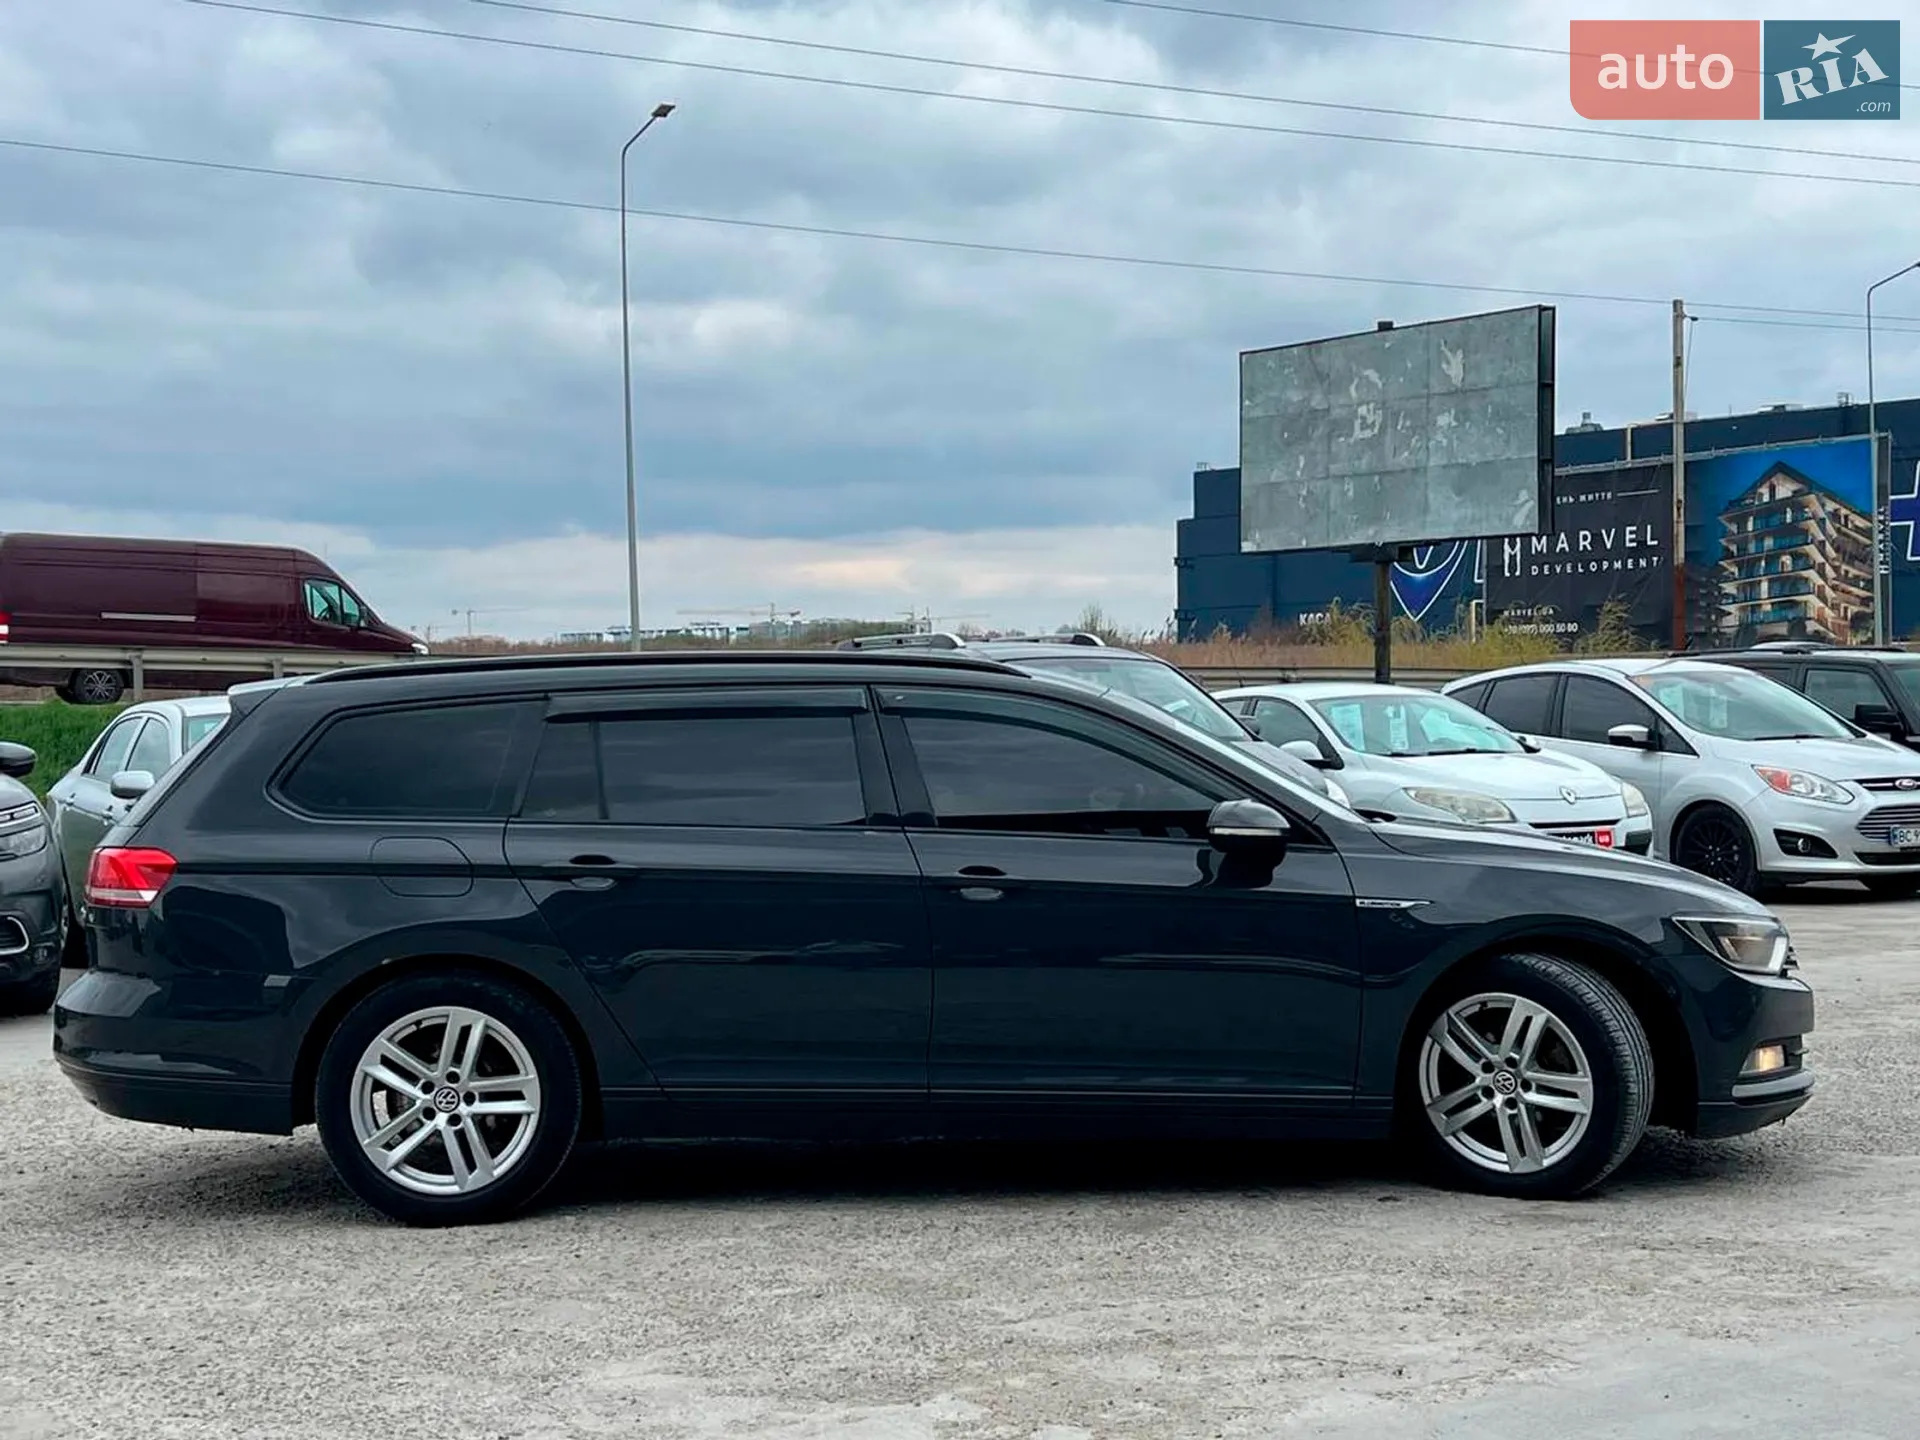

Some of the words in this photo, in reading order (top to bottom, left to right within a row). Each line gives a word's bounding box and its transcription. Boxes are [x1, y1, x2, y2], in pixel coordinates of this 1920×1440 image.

[1555, 495, 1575, 505] ЕНЬ
[1531, 524, 1659, 555] MARVEL
[1531, 556, 1660, 576] DEVELOPMENT
